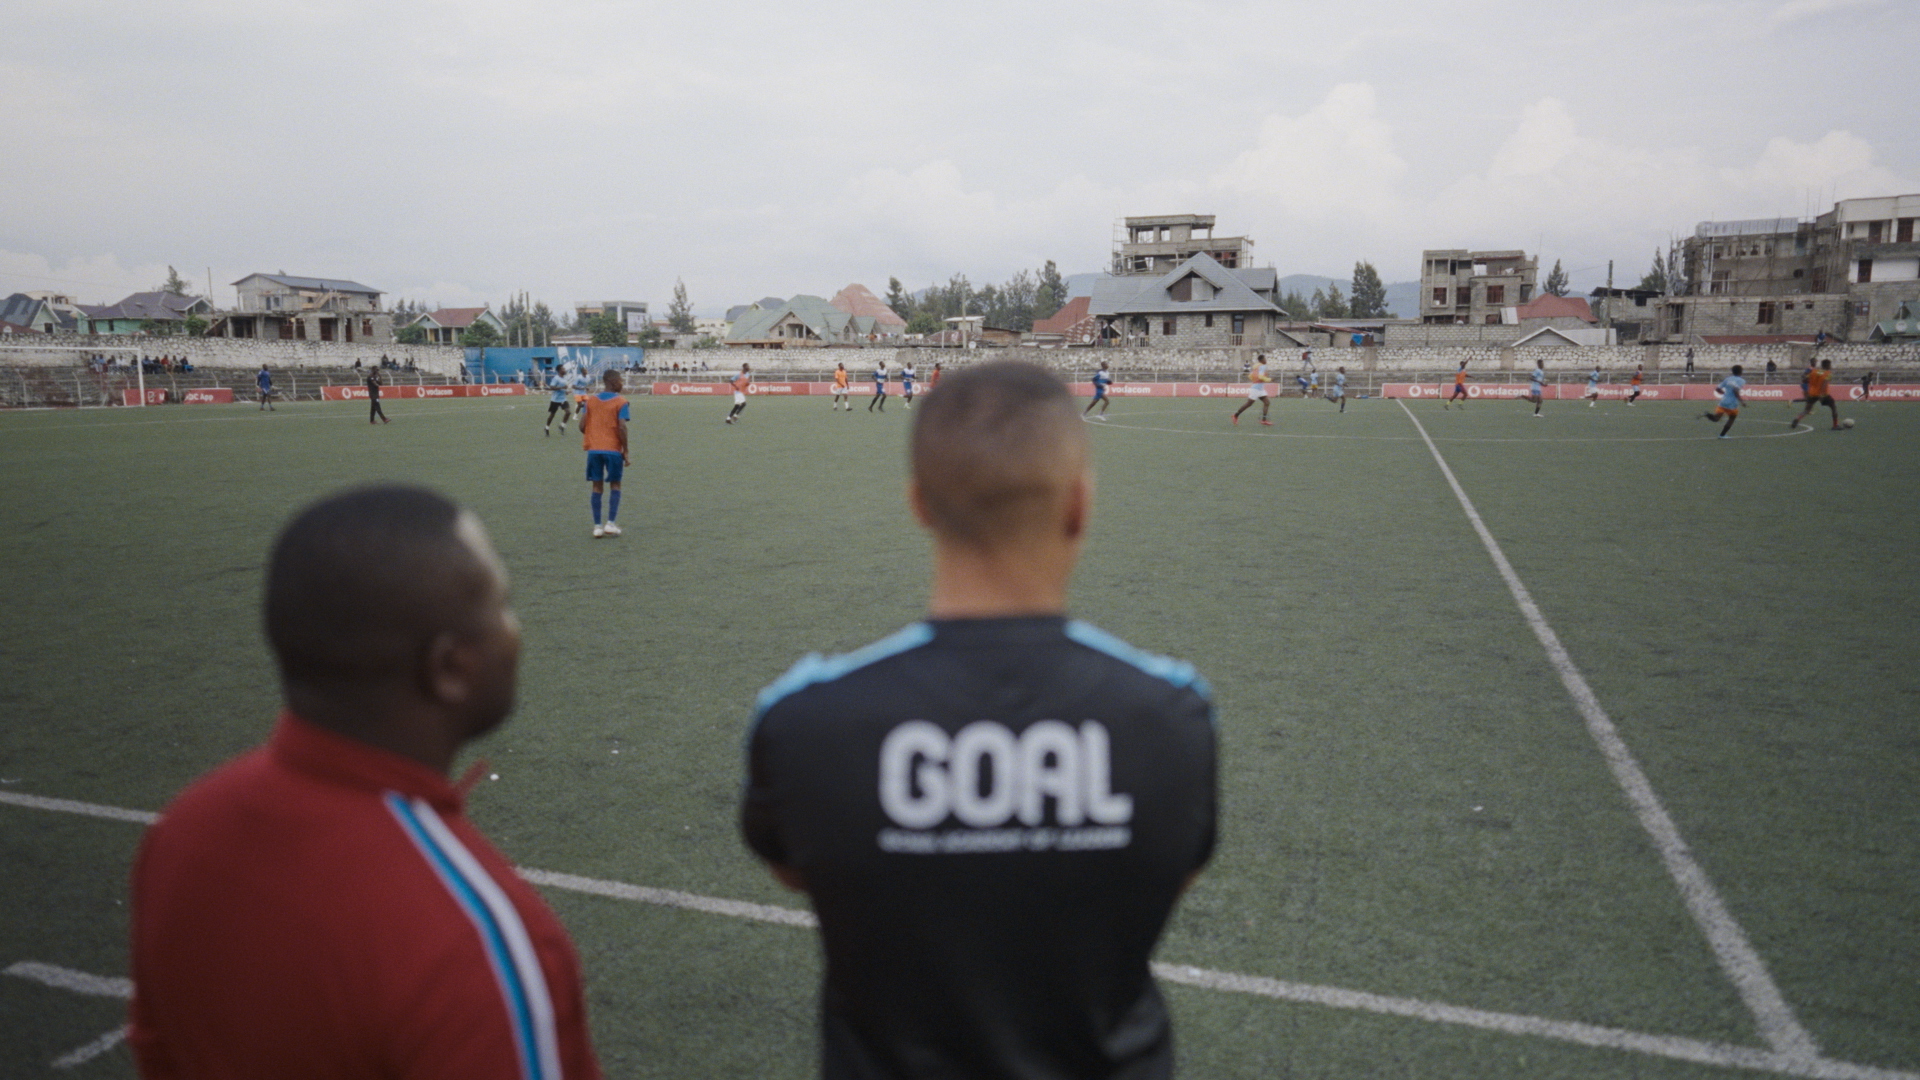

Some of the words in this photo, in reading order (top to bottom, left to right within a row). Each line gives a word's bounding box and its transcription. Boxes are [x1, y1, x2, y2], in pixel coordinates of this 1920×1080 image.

[426, 388, 453, 396] vodacom
[1111, 385, 1150, 394] vodacom
[1483, 387, 1529, 395] vodacom
[1740, 388, 1783, 397] odacom
[200, 393, 213, 402] App
[878, 718, 1133, 829] GOAL
